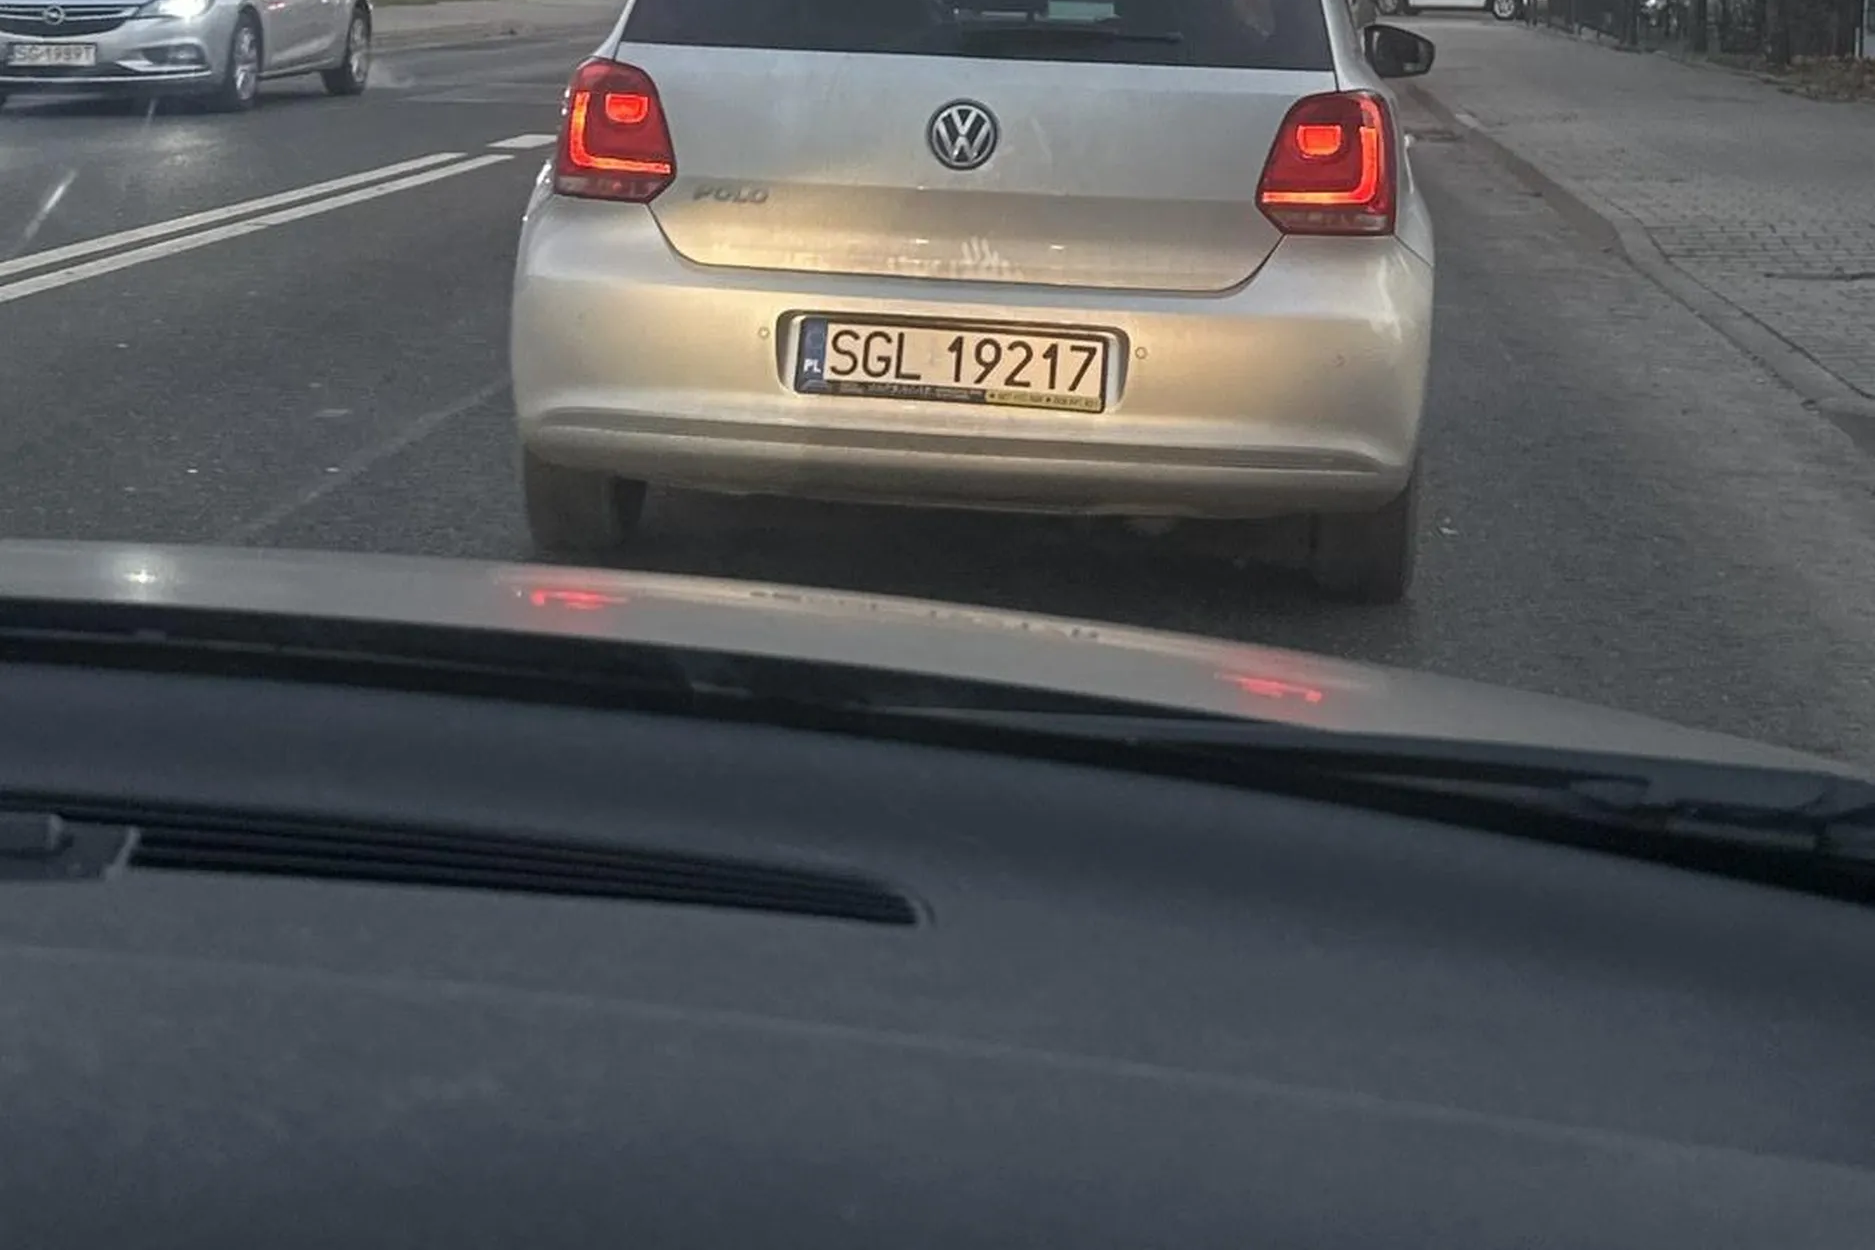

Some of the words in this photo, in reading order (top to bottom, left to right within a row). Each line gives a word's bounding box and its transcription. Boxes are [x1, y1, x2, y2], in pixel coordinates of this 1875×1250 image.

[692, 185, 770, 203] POLO
[803, 358, 822, 373] PL
[829, 329, 922, 380] SGL
[947, 335, 1099, 391] 19217
